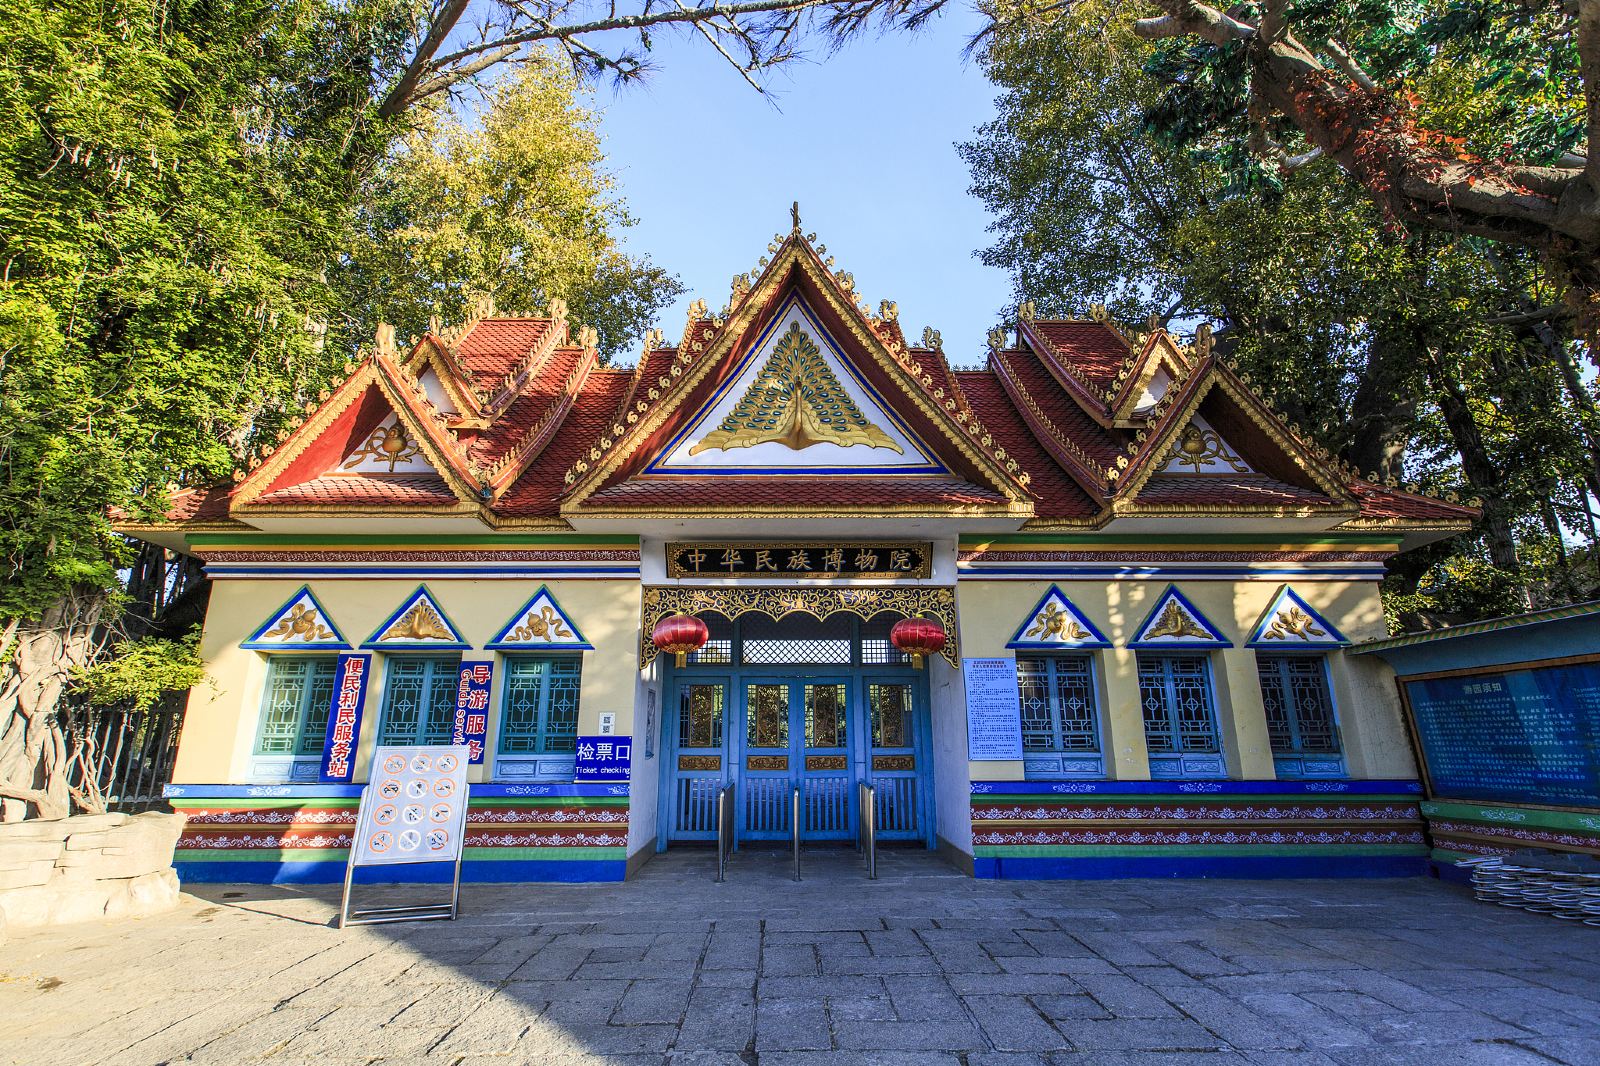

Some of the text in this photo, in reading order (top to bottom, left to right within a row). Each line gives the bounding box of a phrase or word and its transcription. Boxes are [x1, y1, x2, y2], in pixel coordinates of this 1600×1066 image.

[688, 548, 912, 572] 中华民族博物院
[458, 669, 472, 708] Guide
[327, 657, 364, 778] 便民利民服务站
[465, 665, 490, 761] 导游服务
[577, 743, 630, 761] 检票口
[576, 766, 631, 775] Ticket checking
